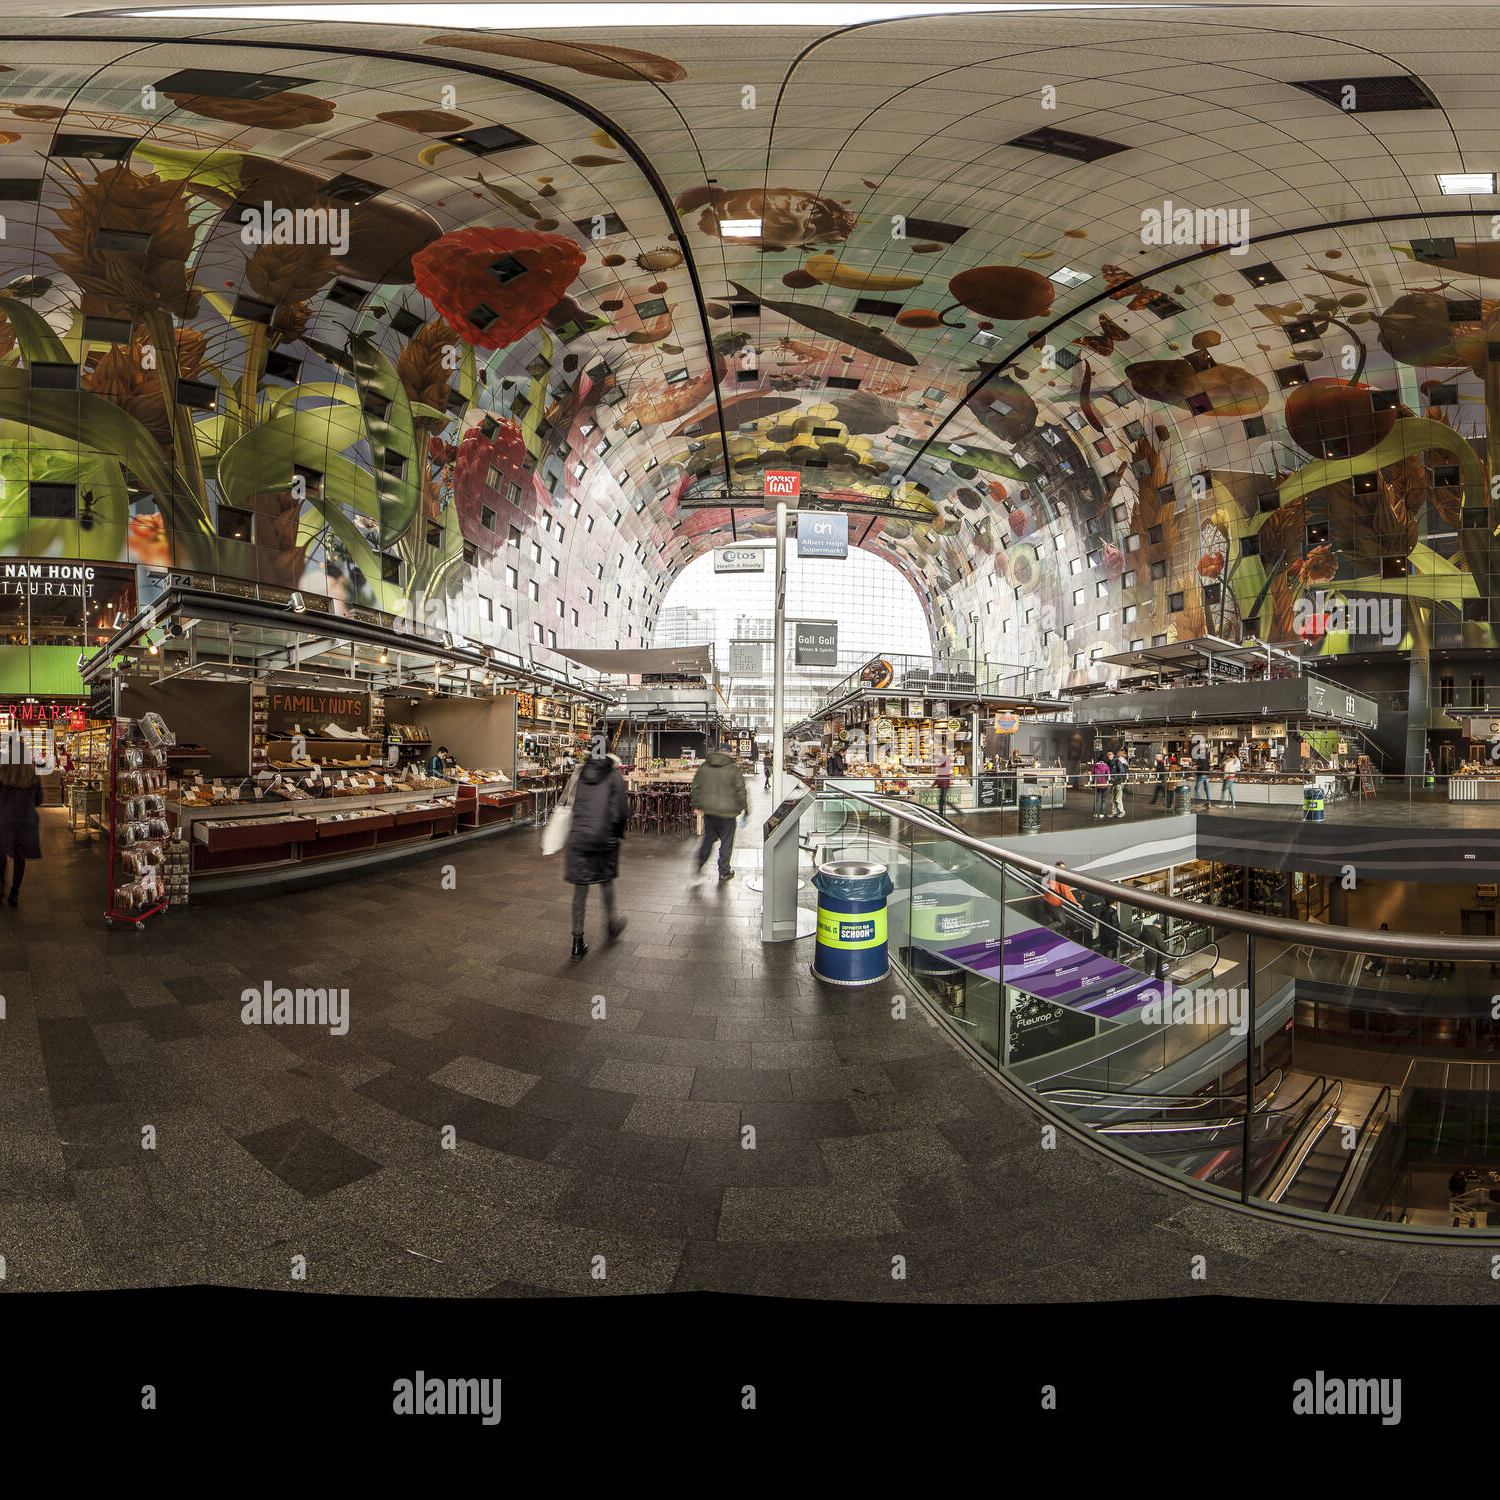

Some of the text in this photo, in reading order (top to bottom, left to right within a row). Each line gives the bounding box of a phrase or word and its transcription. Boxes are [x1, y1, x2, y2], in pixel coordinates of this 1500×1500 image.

[769, 480, 793, 493] HAL
[5, 565, 40, 578] NAM
[49, 565, 95, 580] HONG
[172, 575, 192, 587] 74
[798, 635, 815, 644] Gall
[819, 636, 835, 645] Gall
[273, 694, 362, 716] FAMILY NUTS
[1016, 1012, 1052, 1028] Fleurop
